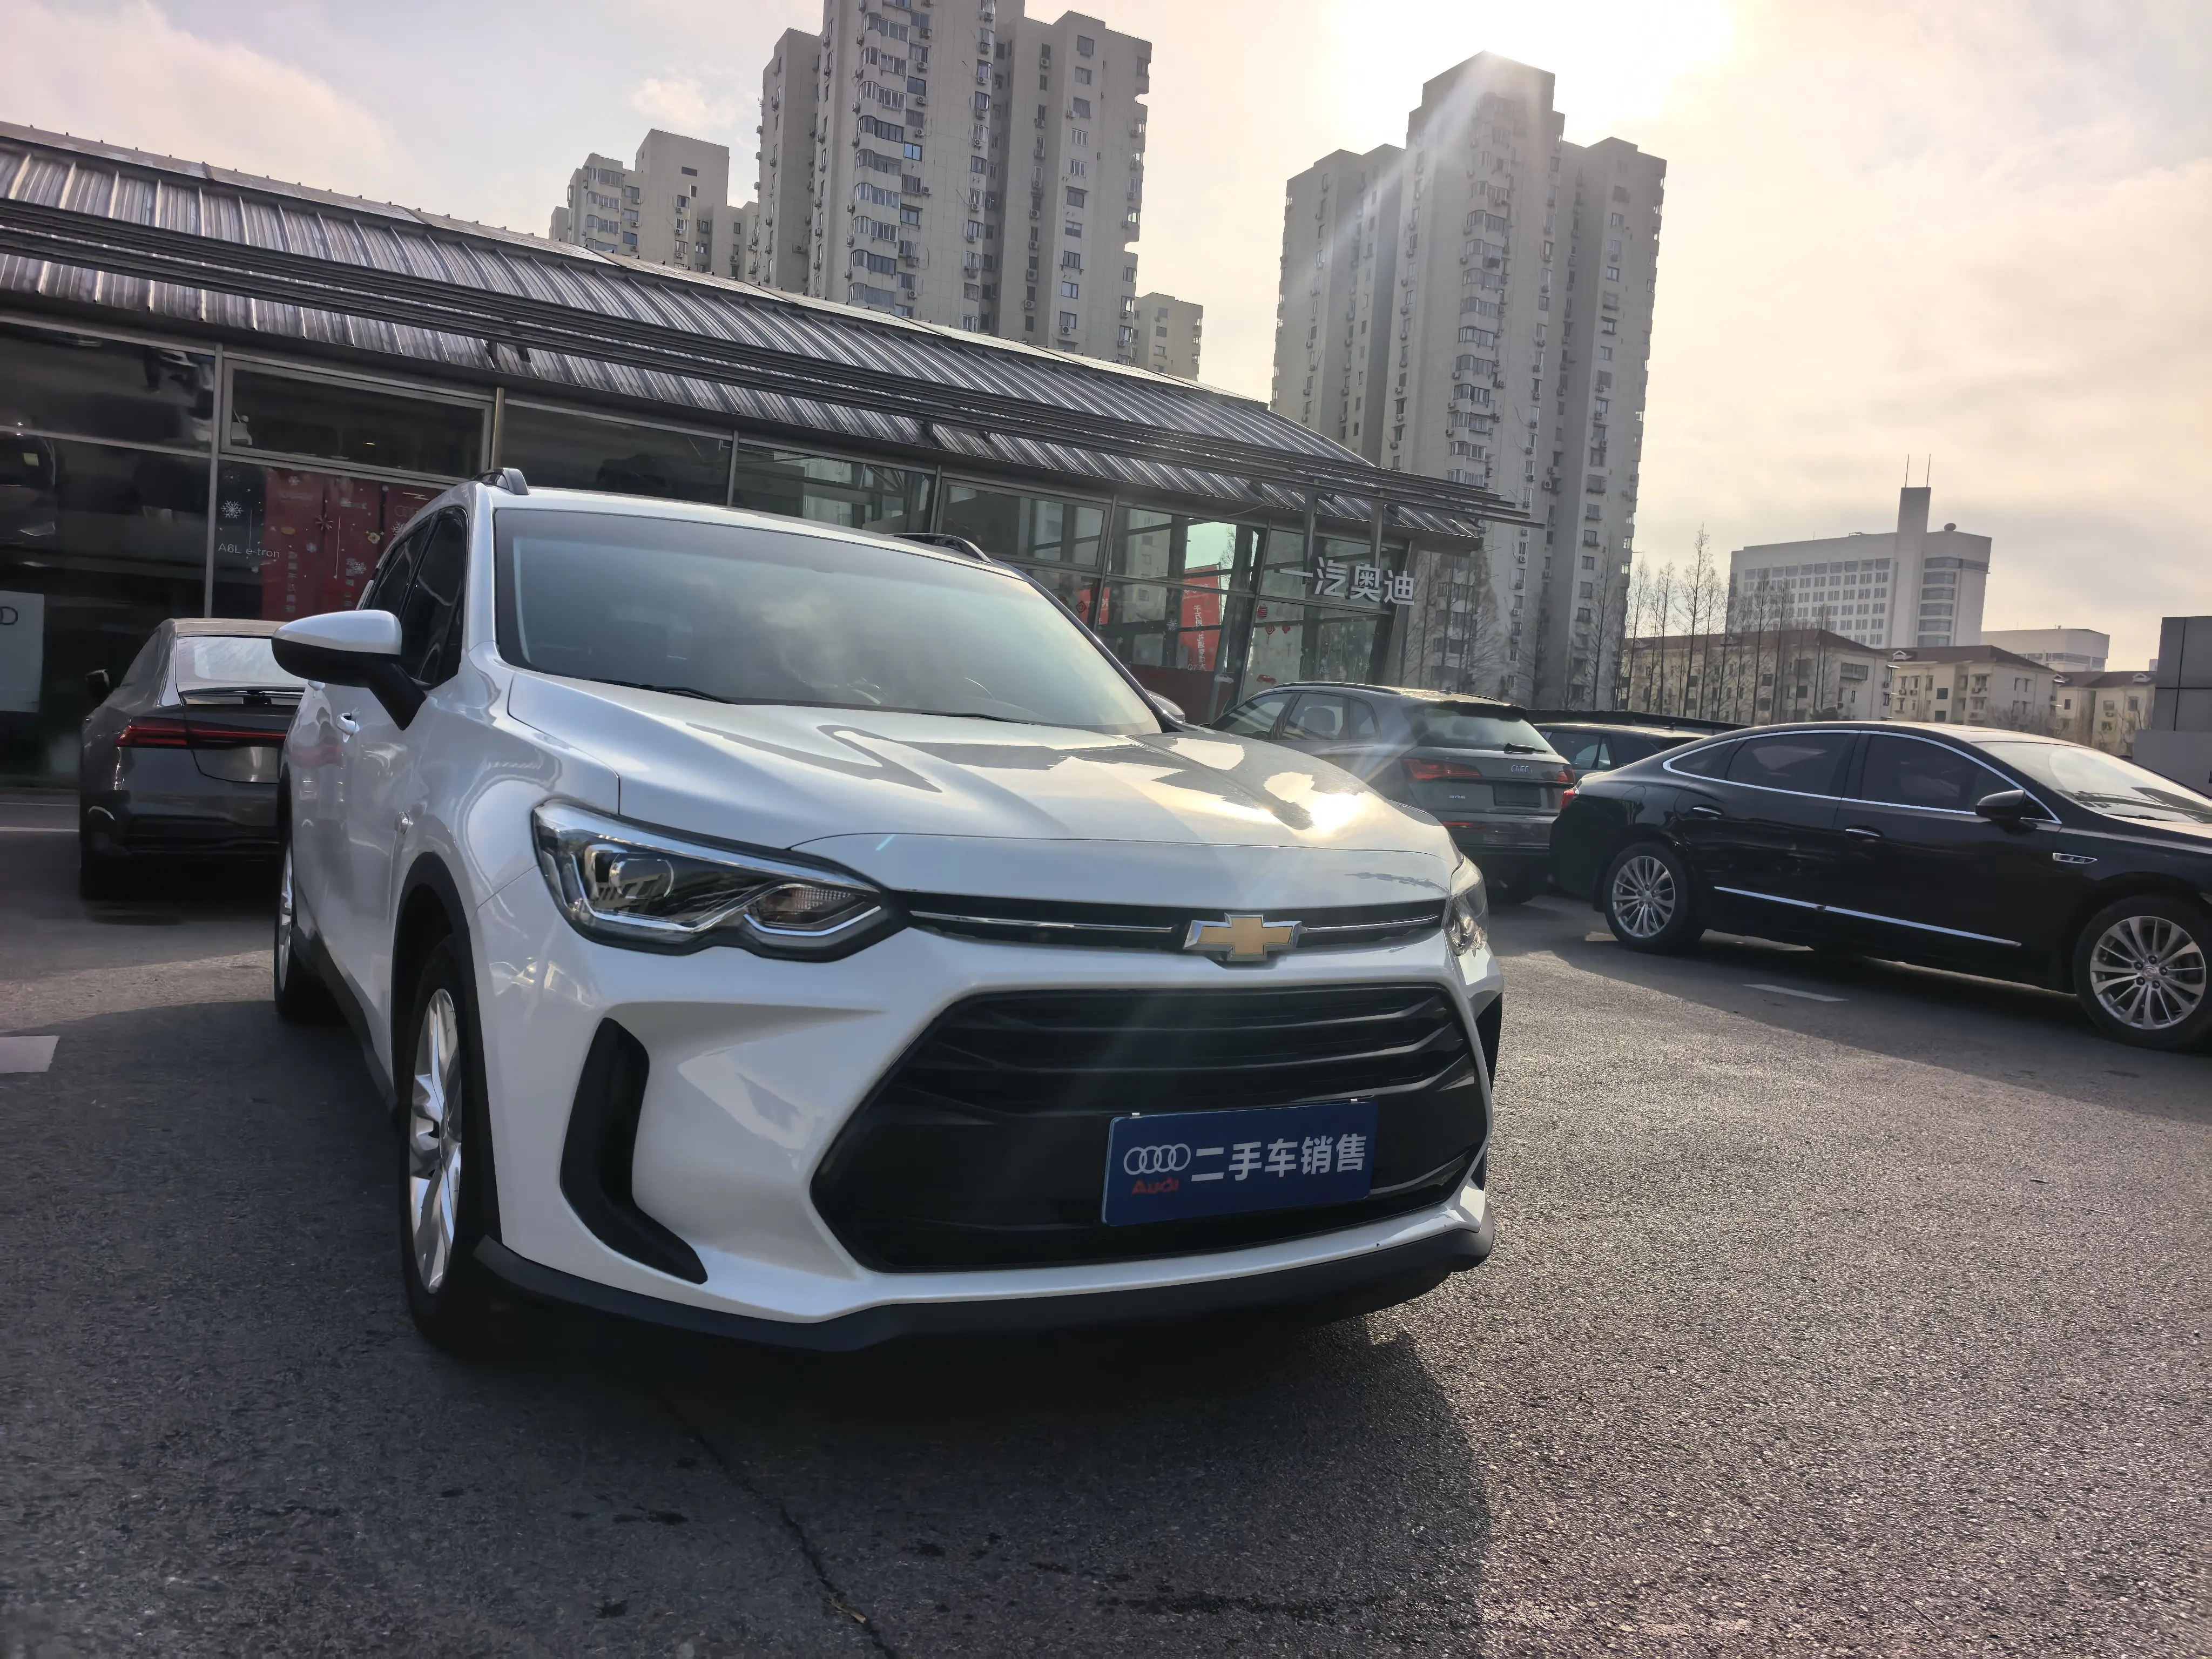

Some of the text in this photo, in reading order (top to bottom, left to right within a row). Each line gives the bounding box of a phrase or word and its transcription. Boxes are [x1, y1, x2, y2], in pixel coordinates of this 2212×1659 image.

[218, 543, 280, 558] A6L e-tron
[1279, 556, 1414, 605] 一汽奥迪
[1191, 1132, 1367, 1182] 二手车销售
[1130, 1177, 1179, 1195] Audi
